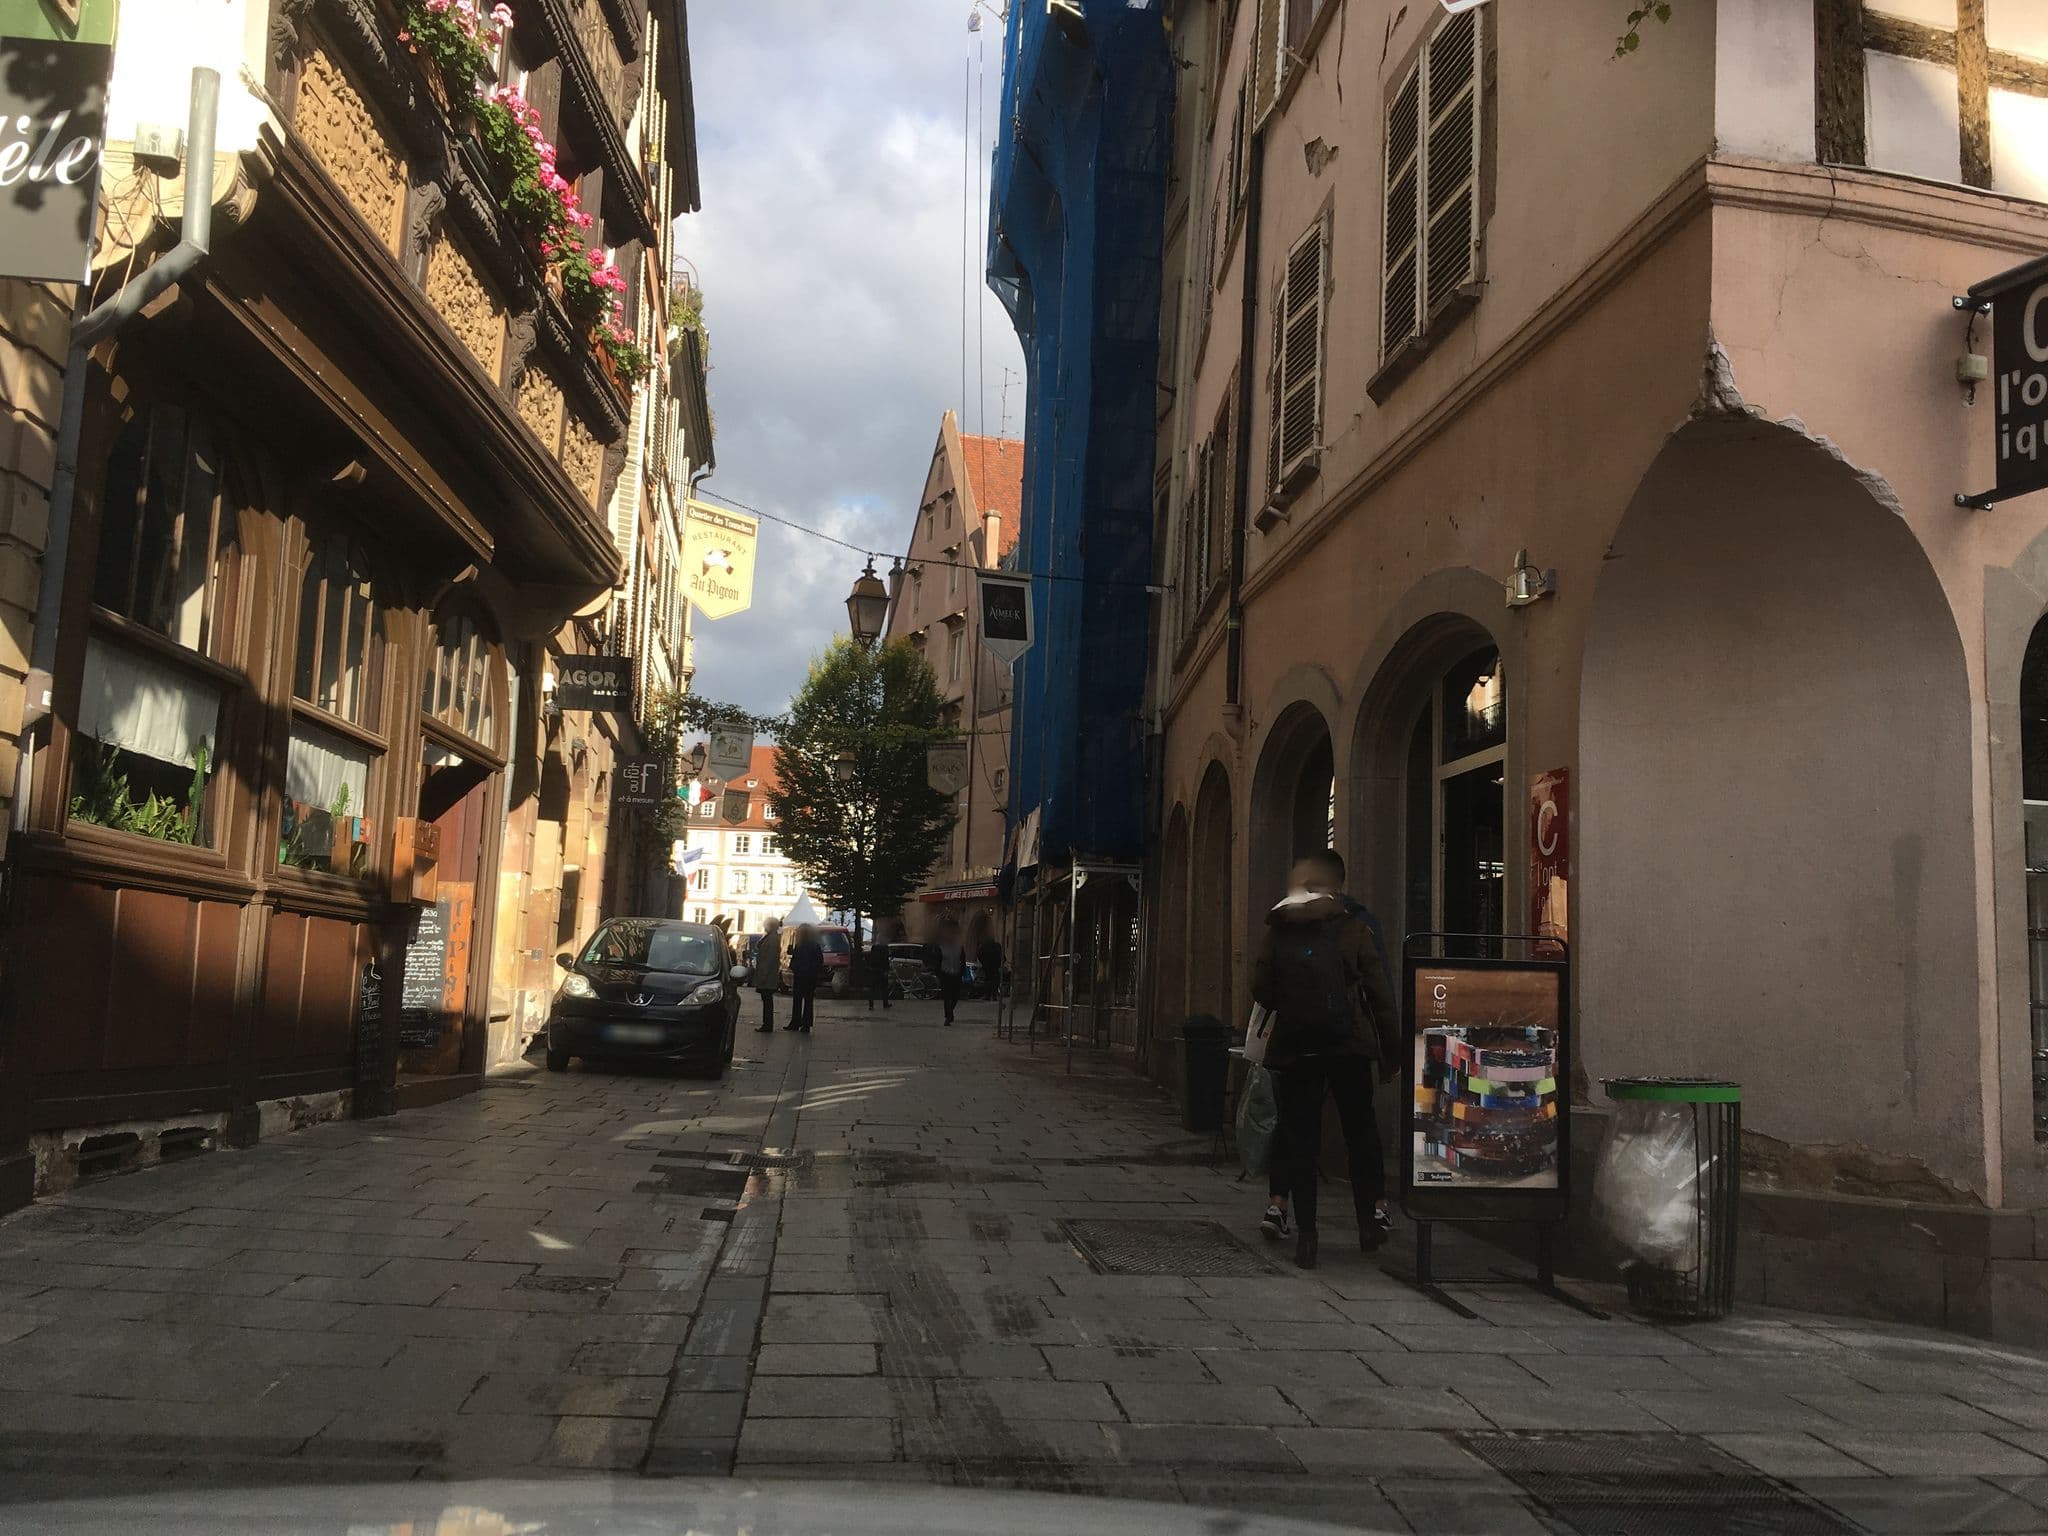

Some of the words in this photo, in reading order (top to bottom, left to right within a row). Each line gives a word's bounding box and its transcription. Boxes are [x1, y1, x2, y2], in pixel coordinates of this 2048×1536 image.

[692, 531, 747, 555] RESTAURANT
[707, 577, 739, 601] Pigeon
[1537, 799, 1559, 856] C
[1433, 984, 1447, 1000] C
